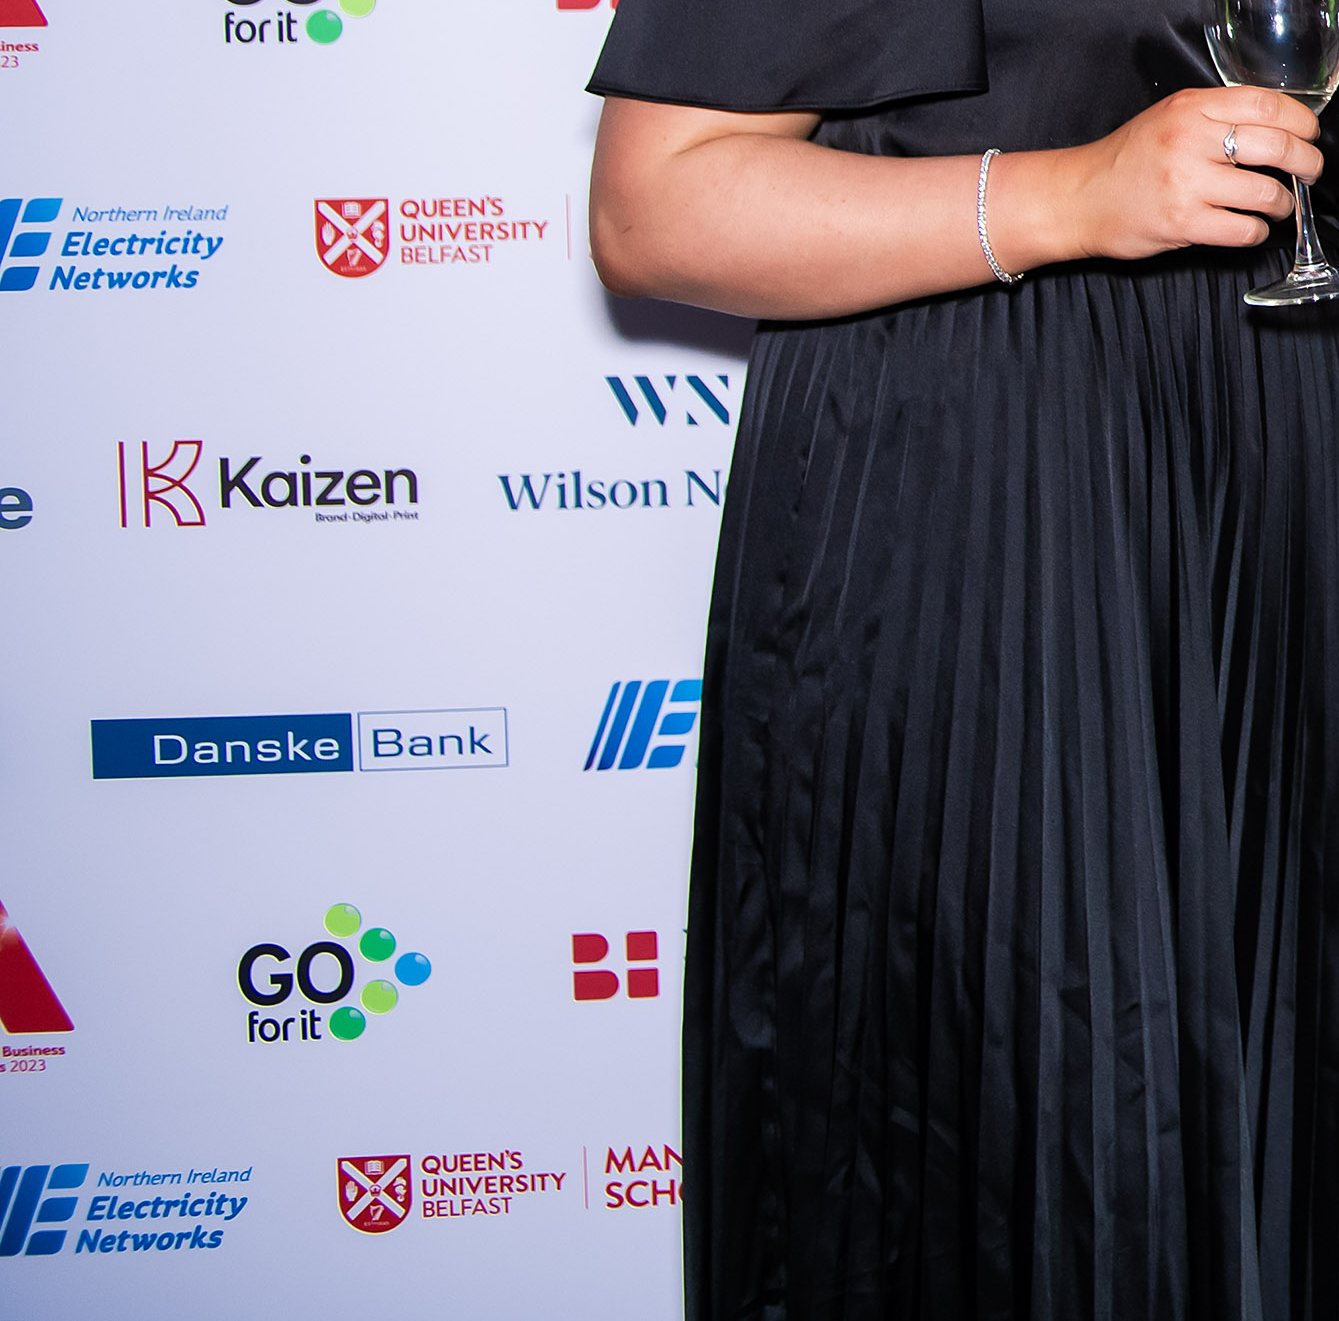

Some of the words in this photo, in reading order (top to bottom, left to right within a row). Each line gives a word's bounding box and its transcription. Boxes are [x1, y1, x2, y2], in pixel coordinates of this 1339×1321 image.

[225, 12, 271, 43] for
[277, 12, 297, 42] it
[0, 41, 39, 52] iness
[1, 55, 19, 68] 23
[72, 206, 157, 222] Northern
[163, 205, 228, 221] Ireland
[400, 196, 503, 220] QUEEN'S
[400, 222, 547, 242] UNIVERSITY
[61, 230, 223, 260] Electricity
[401, 245, 492, 264] BELFAST
[49, 264, 199, 290] Networks
[220, 454, 418, 508] Kaizen
[498, 471, 669, 510] Wilson
[154, 731, 339, 764] Danske
[373, 726, 492, 757] Bank
[238, 941, 354, 1006] GO
[248, 1011, 295, 1042] for
[301, 1009, 321, 1040] it
[2, 1045, 65, 1057] Business
[10, 1059, 46, 1072] 2023
[421, 1150, 523, 1175] QUEEN'S
[97, 1171, 181, 1187] Northern
[187, 1167, 252, 1183] Ireland
[422, 1173, 566, 1197] UNIVERSITY
[86, 1192, 248, 1221] Electricity
[605, 1179, 682, 1209] SCH
[423, 1197, 512, 1217] BELFAST
[75, 1225, 224, 1254] Networks
